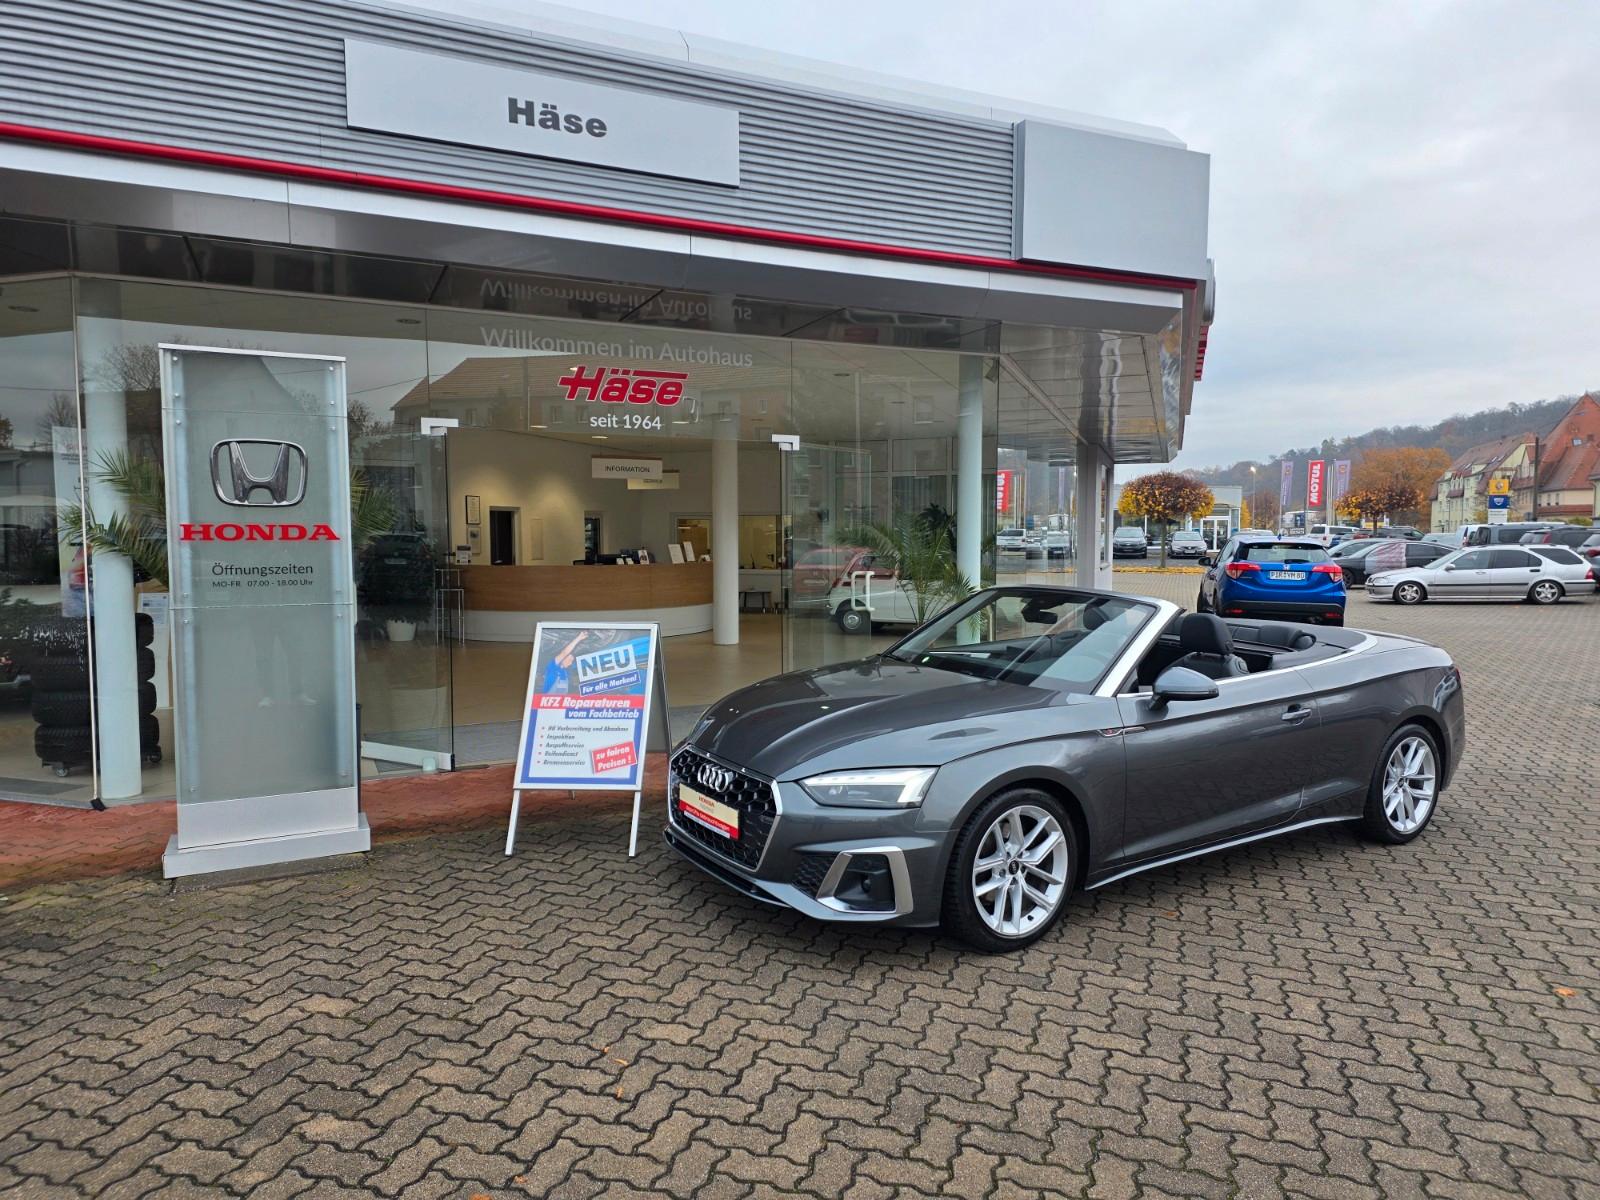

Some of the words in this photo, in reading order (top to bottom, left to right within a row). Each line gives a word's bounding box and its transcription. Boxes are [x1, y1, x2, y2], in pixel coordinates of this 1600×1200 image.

[507, 97, 607, 137] Häse
[480, 327, 622, 357] Willkommen
[629, 339, 654, 360] im
[659, 342, 753, 368] Autohaus
[558, 365, 689, 406] Häse
[590, 413, 618, 428] seit
[623, 415, 662, 430] 1964
[605, 465, 650, 473] INFORMATION
[1310, 464, 1320, 504] MOTUL
[179, 523, 341, 541] HONDA
[212, 562, 313, 577] Öffnungszeiten
[277, 579, 298, 587] 18.00
[580, 648, 630, 677] NEU
[595, 683, 608, 691] alle
[609, 674, 637, 688] Marken!
[540, 697, 562, 707] KFZ
[562, 697, 630, 709] Reparaturen
[589, 709, 639, 718] Fachbetrieb
[596, 752, 606, 760] zu
[606, 746, 630, 758] fairen
[597, 759, 626, 771] Preisen
